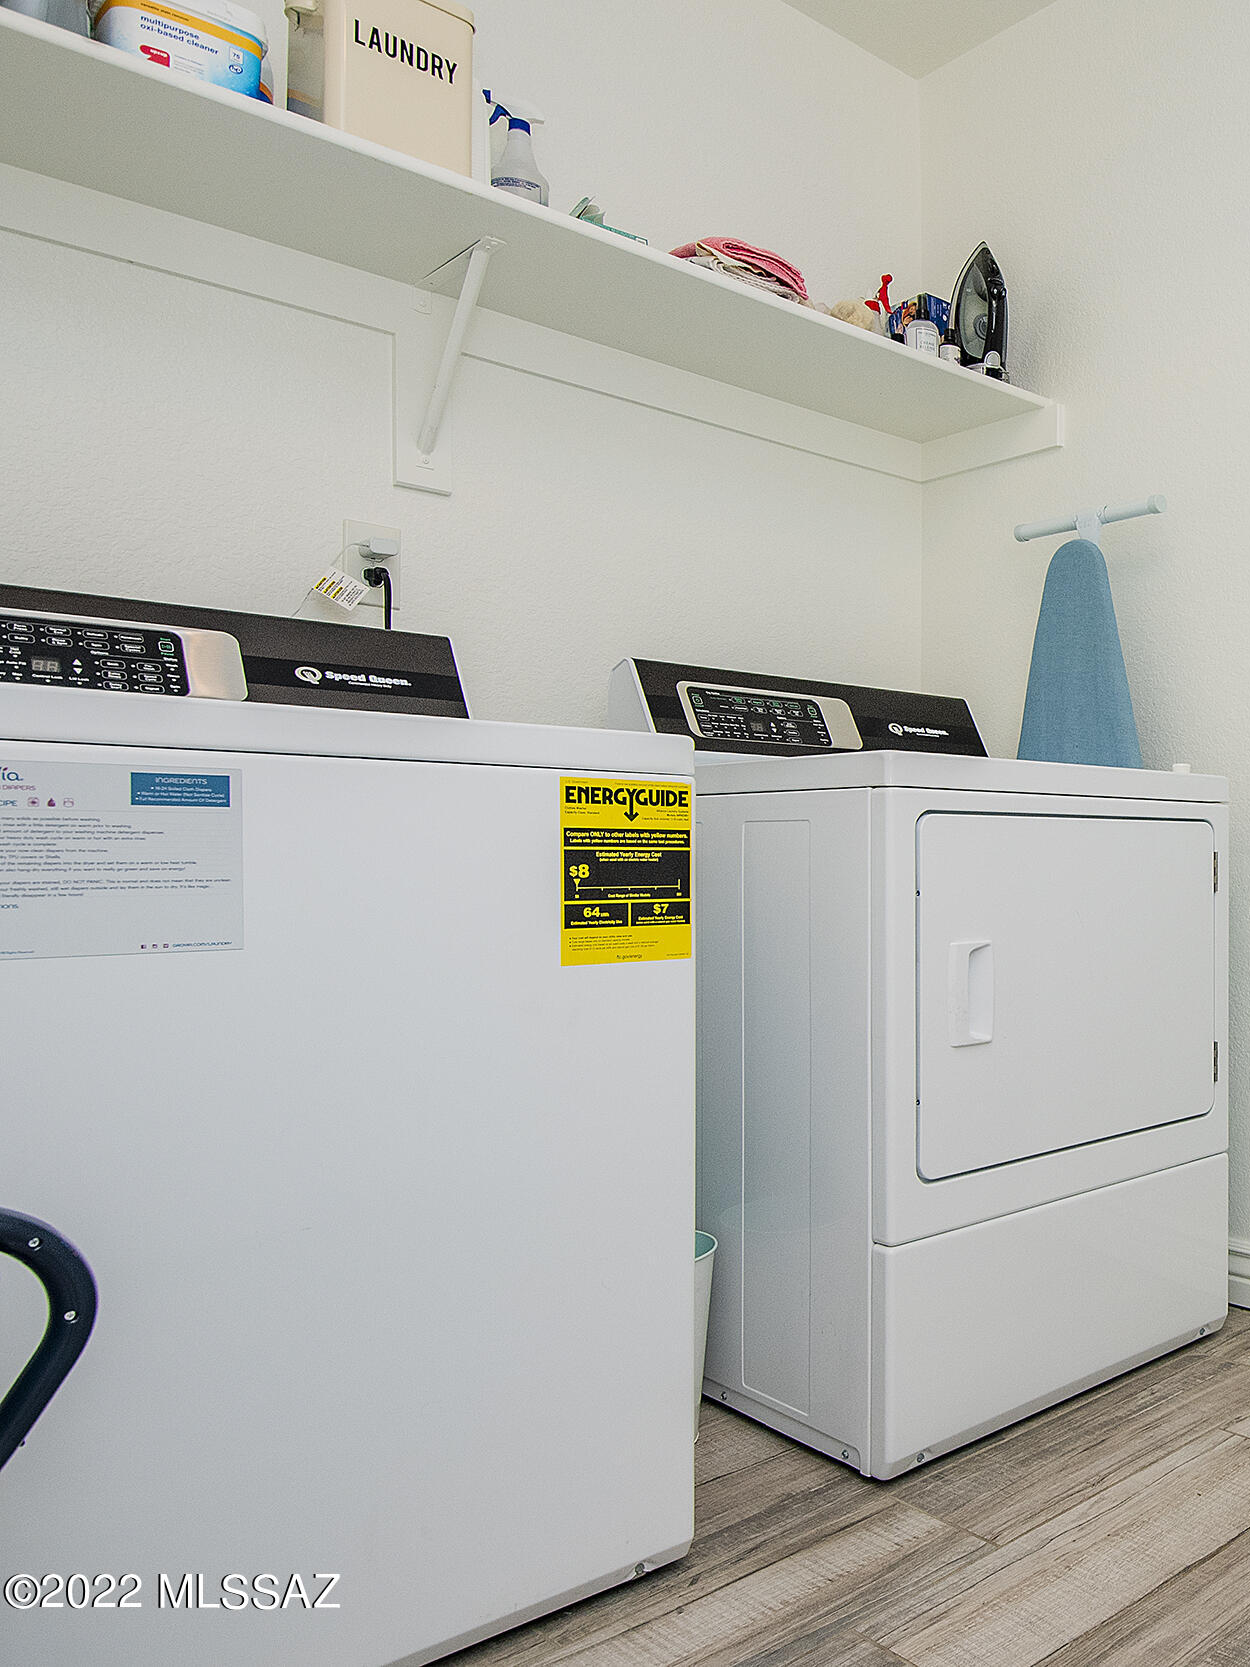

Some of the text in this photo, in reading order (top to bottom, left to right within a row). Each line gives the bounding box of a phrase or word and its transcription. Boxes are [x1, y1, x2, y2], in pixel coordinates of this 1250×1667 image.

[140, 15, 200, 40] multipurpose
[140, 23, 219, 56] oxi-based cleaner
[354, 18, 458, 85] LAUNDRY
[324, 670, 366, 682] Speed
[0, 767, 20, 781] ia
[155, 776, 208, 785] INGREDIENTS
[565, 786, 688, 808] ENERGYGUIDE
[569, 864, 590, 879] $8
[583, 906, 600, 918] 64
[653, 903, 669, 915] $7
